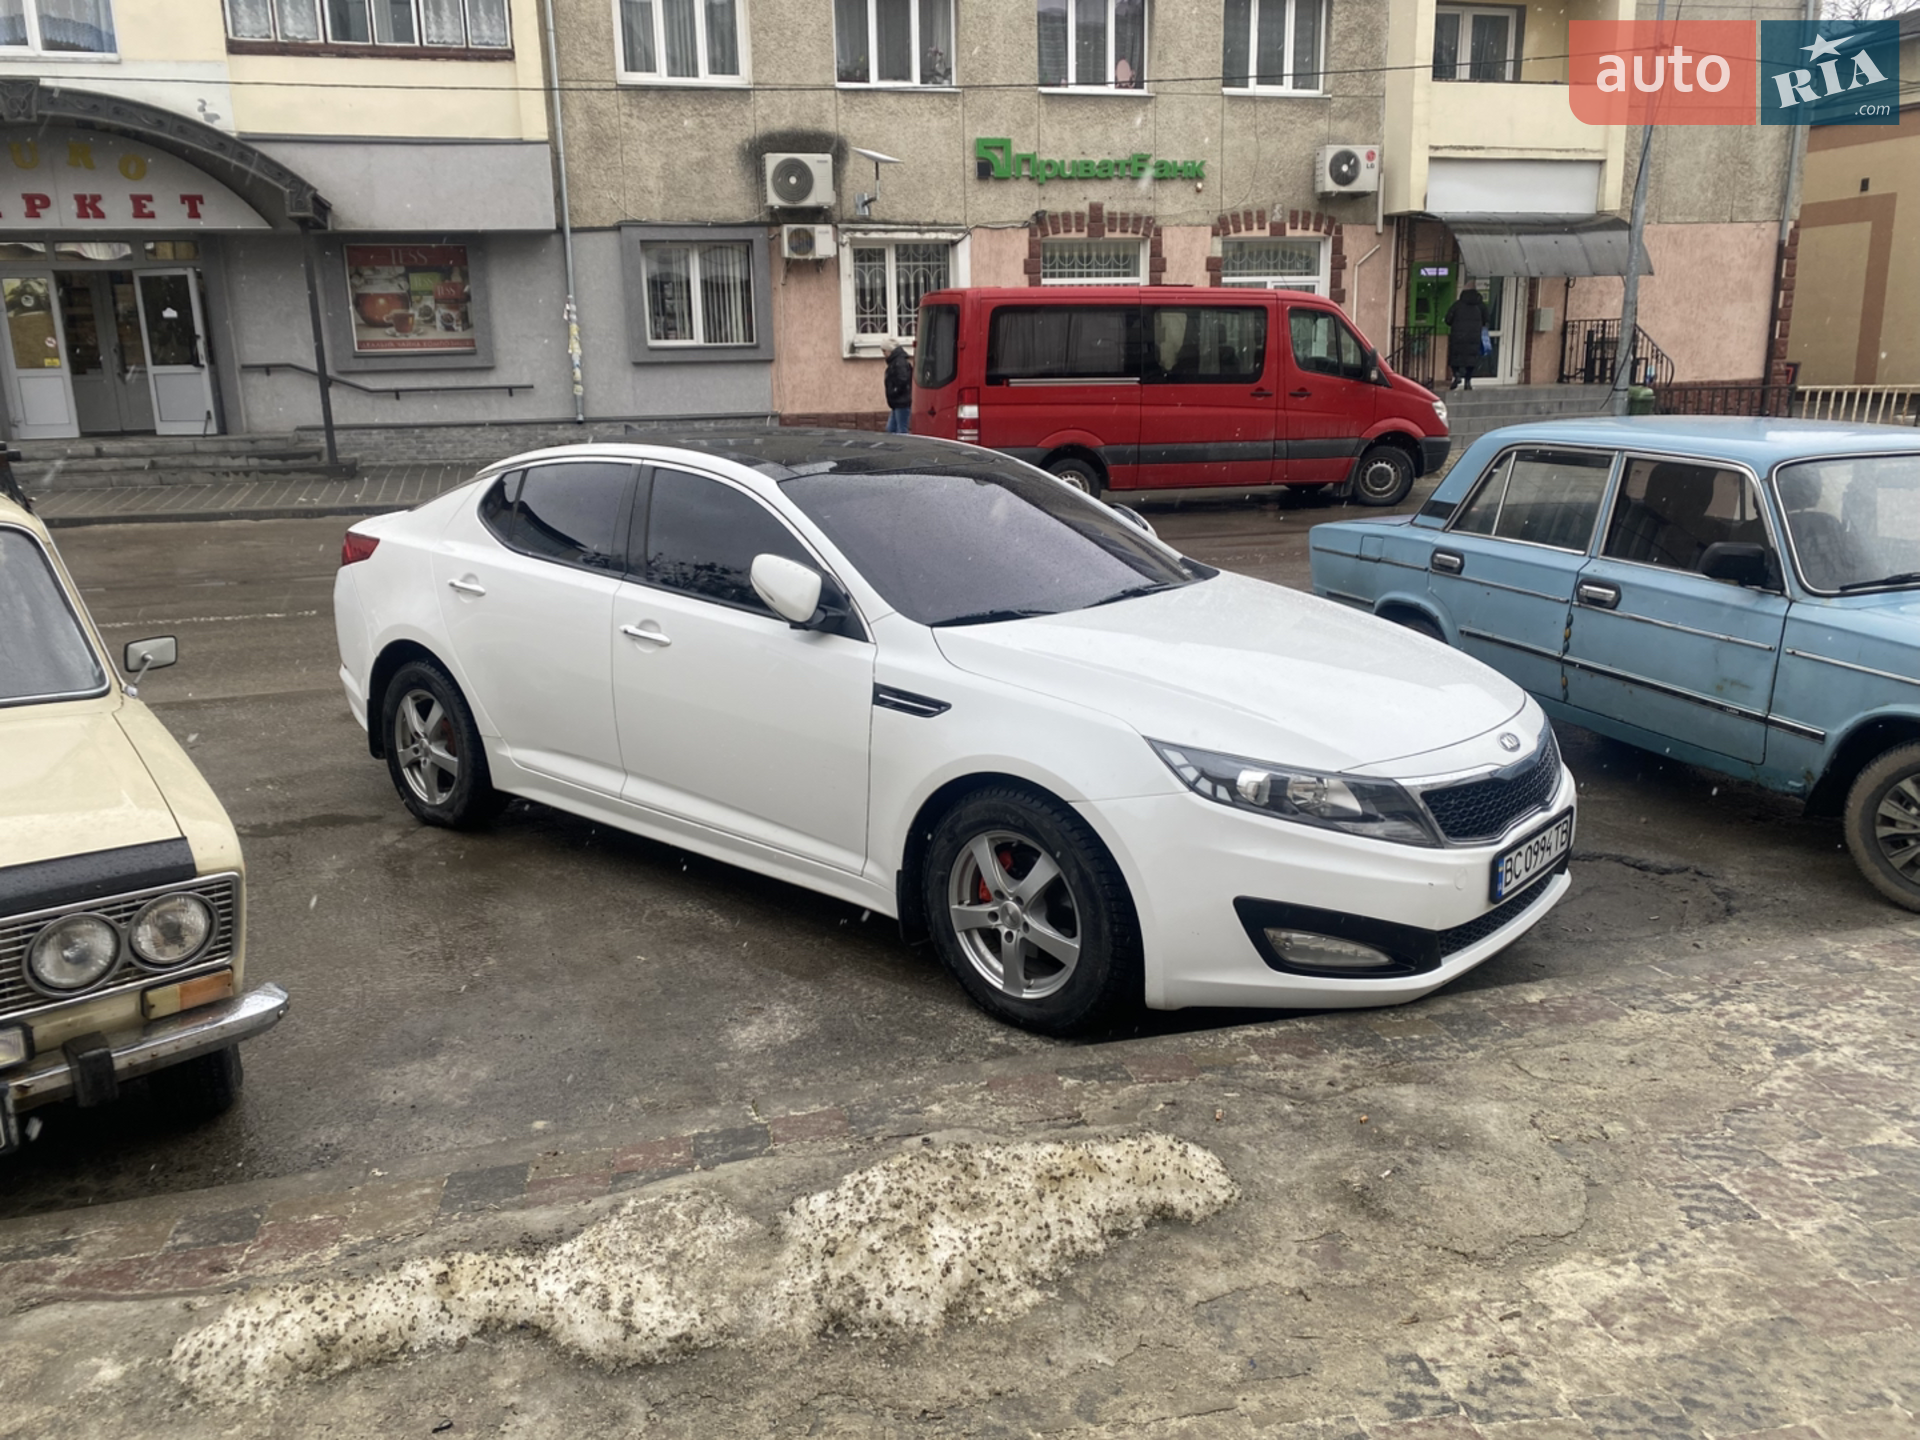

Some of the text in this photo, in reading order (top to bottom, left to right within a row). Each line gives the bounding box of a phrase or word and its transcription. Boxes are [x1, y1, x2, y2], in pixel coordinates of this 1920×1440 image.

[1015, 153, 1206, 185] ПриватБанк
[0, 192, 205, 219] РКЕТ
[1504, 820, 1569, 887] BC 0994 TB
